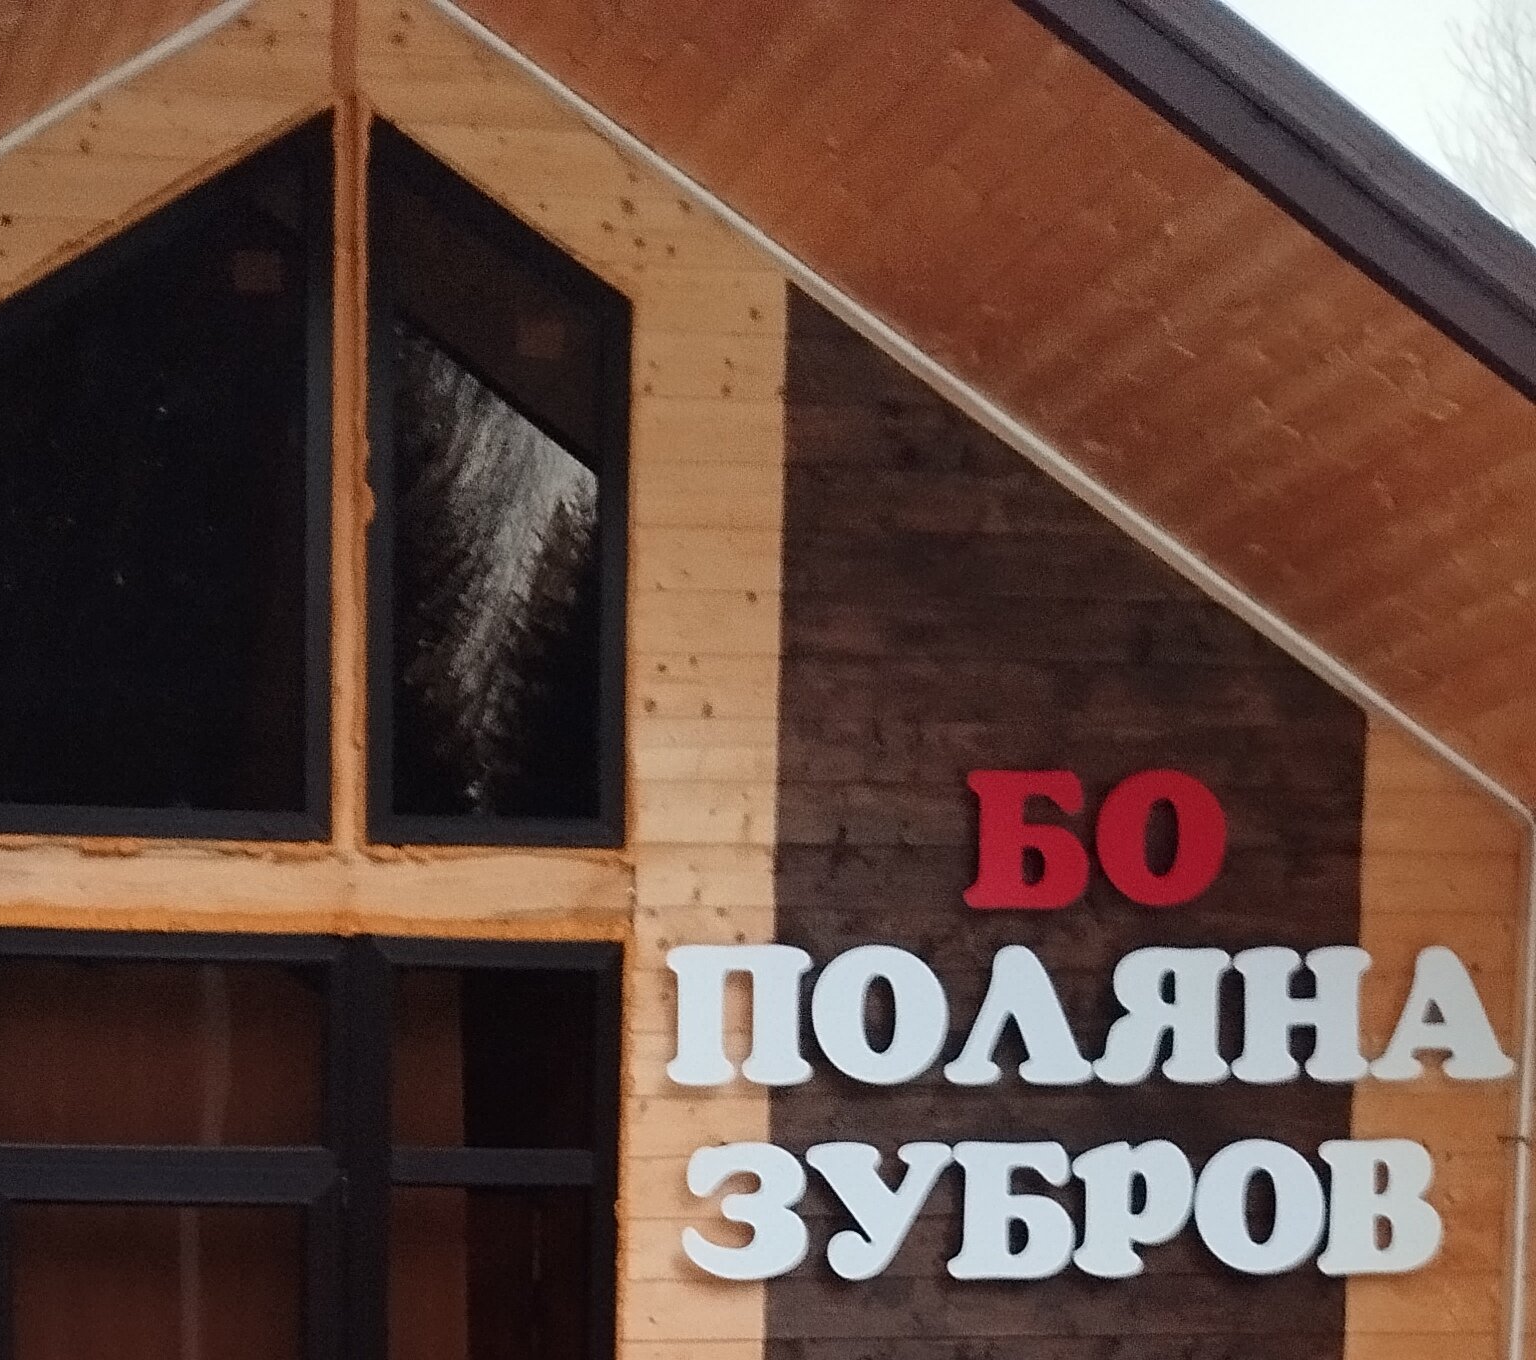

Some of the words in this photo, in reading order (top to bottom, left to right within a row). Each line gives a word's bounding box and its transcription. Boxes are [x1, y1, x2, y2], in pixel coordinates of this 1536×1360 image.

[963, 769, 1228, 910] БО
[666, 943, 1515, 1087] ПОЛЯНА
[680, 1139, 1444, 1281] ЗУБРОВ
